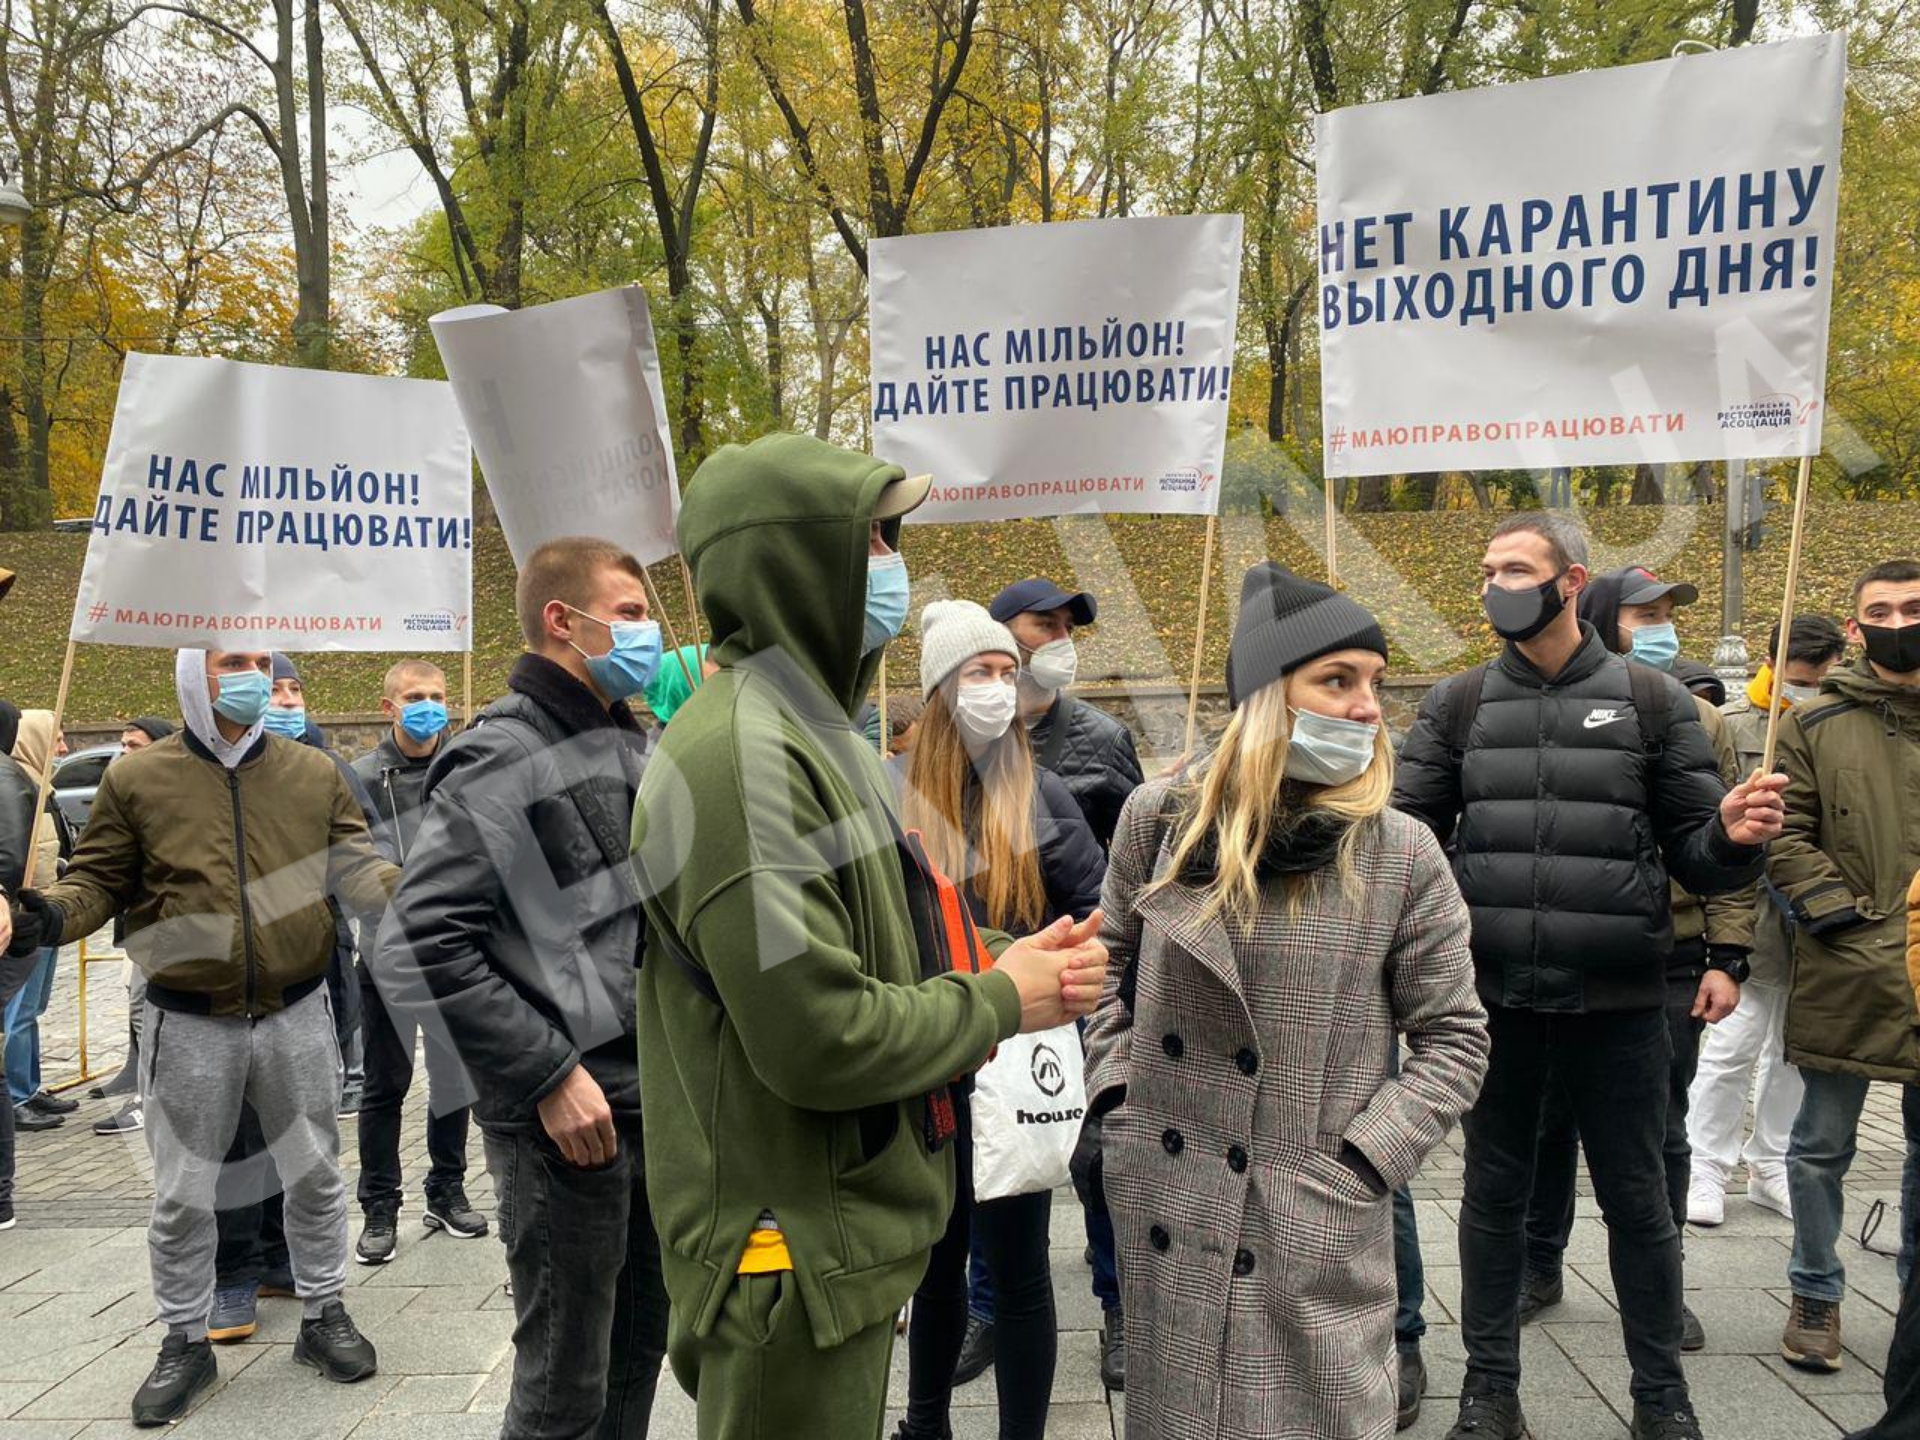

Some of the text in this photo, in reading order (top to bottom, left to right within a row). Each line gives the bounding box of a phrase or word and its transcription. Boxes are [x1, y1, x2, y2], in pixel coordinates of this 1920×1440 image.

[1320, 165, 1825, 273] НЕТ КАРАНТИНУ
[1322, 235, 1819, 330] ВЫХОДНОГО ДНЯ!
[925, 317, 1185, 371] НАС МІЛЬЙОН!
[873, 366, 1230, 421] ДАЙТЕ ПРАЦЮВАТИ!
[1330, 413, 1686, 453] #МАЮПРАВОПРАЦЮВАТИ
[1717, 408, 1792, 421] РЕСТОРАННА
[1721, 417, 1791, 429] АСОЦІАЦІЯ
[147, 455, 419, 506] НАС МІЛЬЙОН!
[928, 476, 1145, 503] АЮПРАВОПРАЦЮВАТИ
[93, 494, 471, 551] ДАЙТЕ ПРАЦЮВАТИ!
[87, 601, 383, 634] #МАЮПРАВОПРАЦЮВАТИ
[1589, 708, 1618, 720] NIKE
[1016, 1107, 1084, 1125] house
